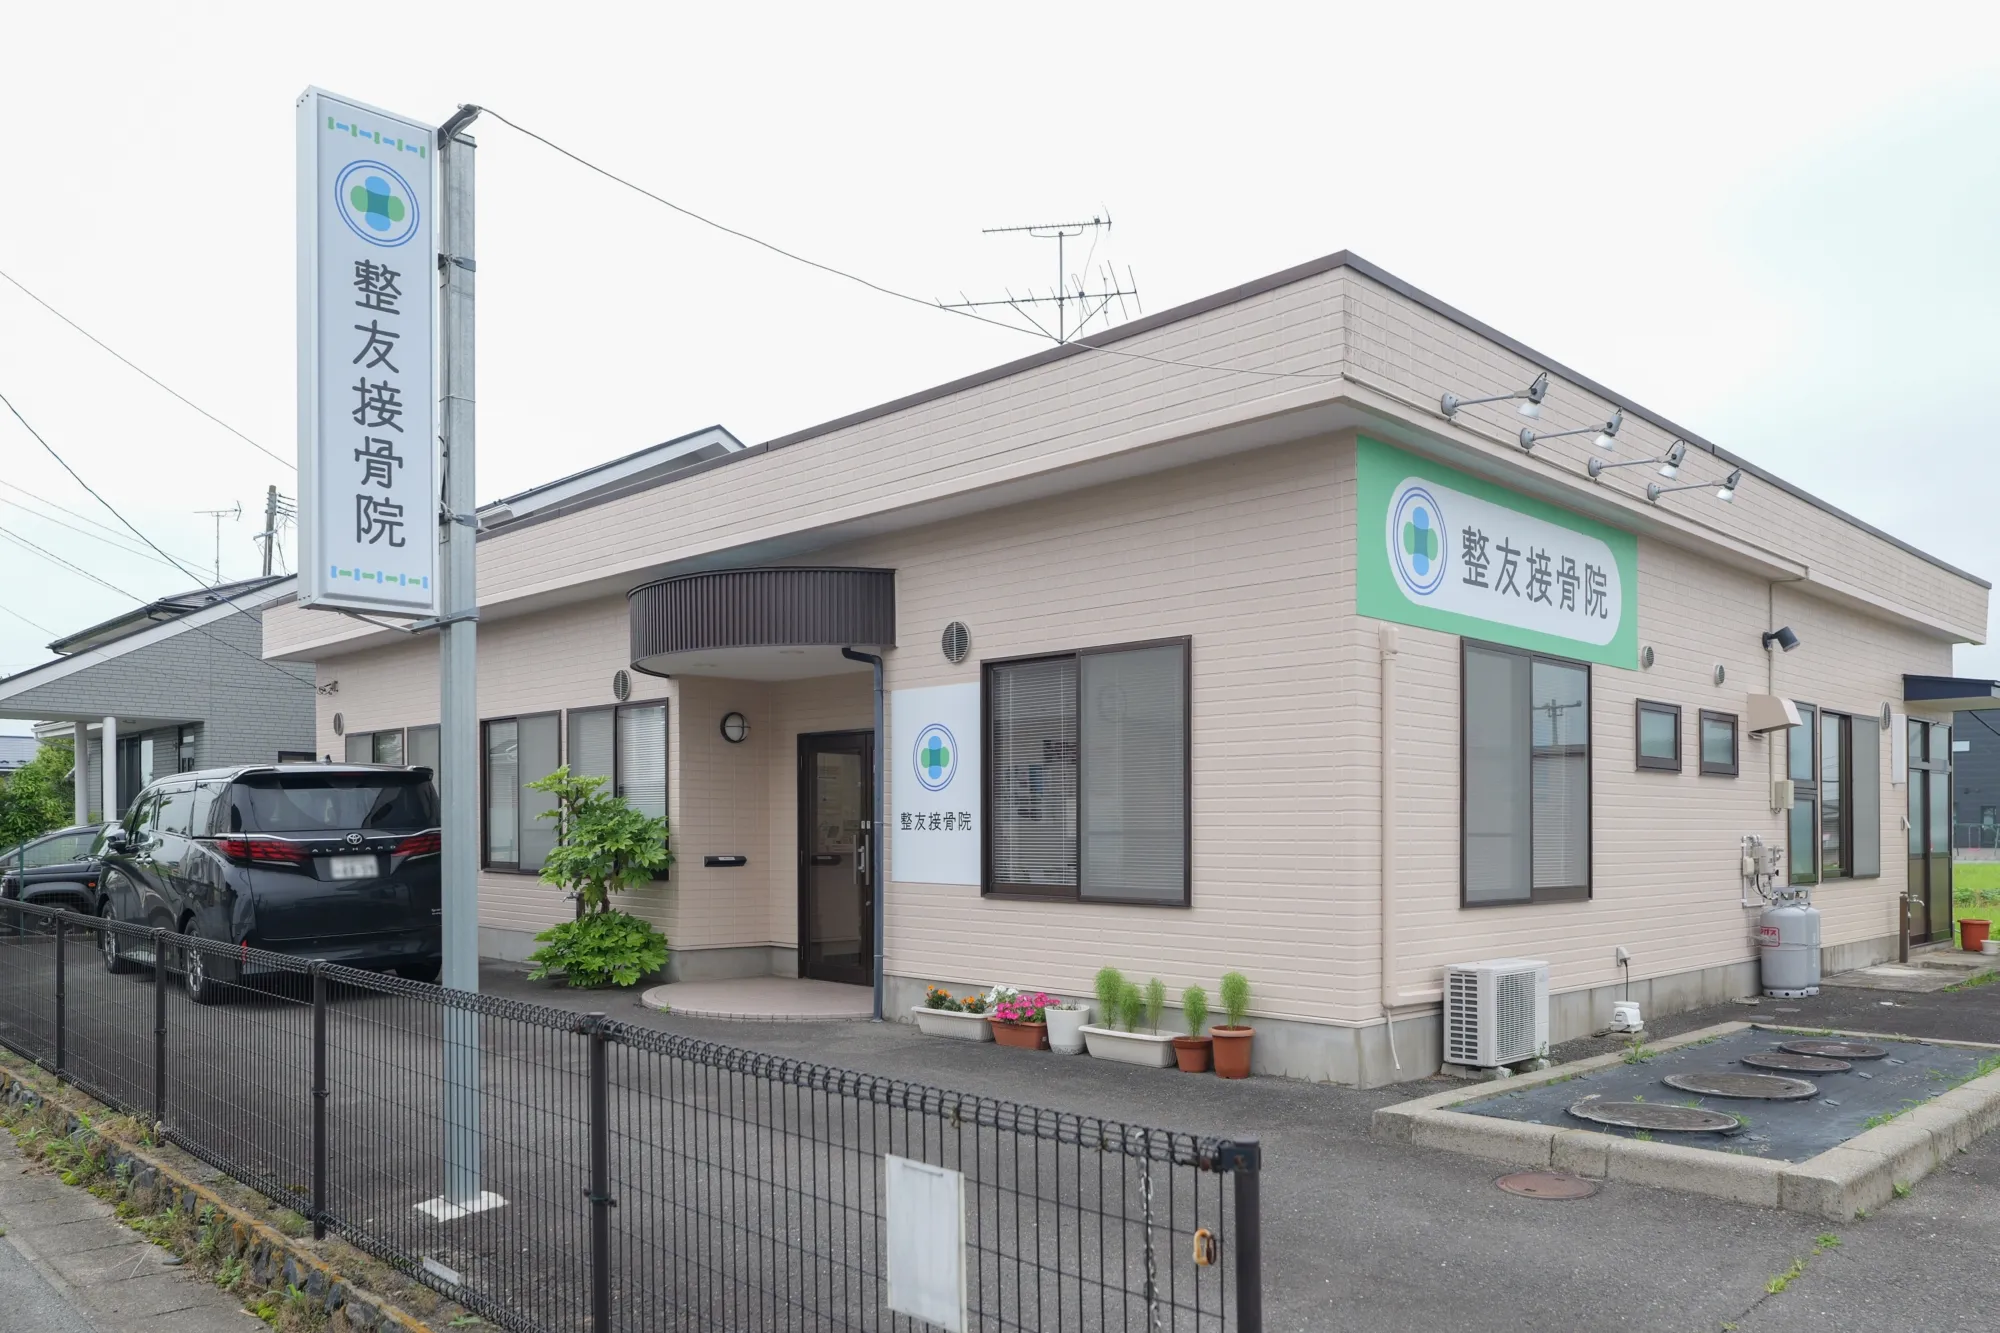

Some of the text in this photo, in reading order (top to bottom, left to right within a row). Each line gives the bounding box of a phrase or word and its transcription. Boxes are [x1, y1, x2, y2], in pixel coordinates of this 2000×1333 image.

[351, 258, 406, 548] 整友接骨院
[1461, 525, 1608, 620] 整友接骨院
[312, 845, 396, 853] ALPHARD
[900, 811, 972, 831] 整友接骨院
